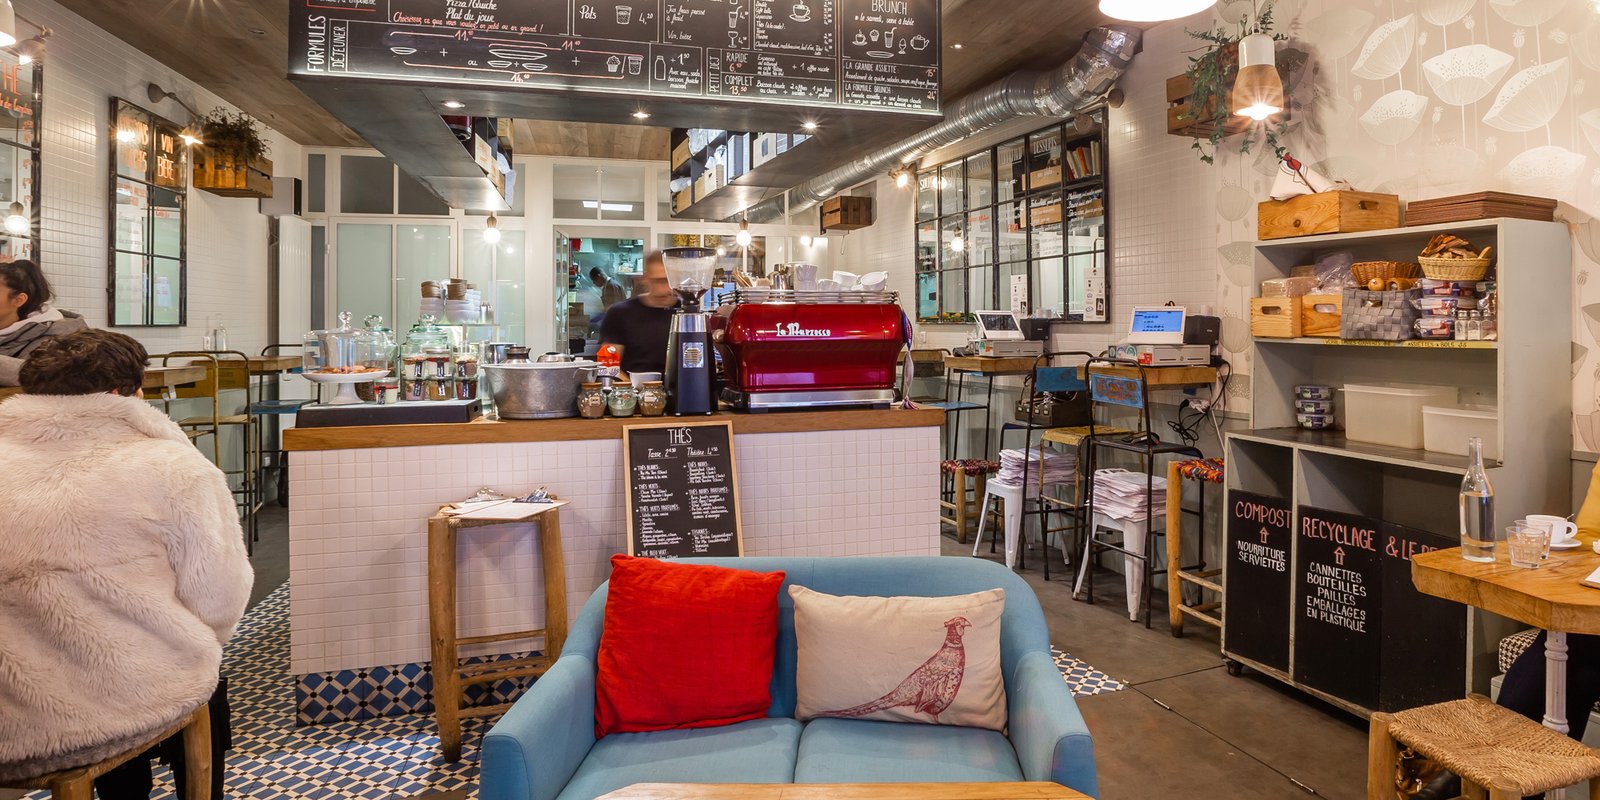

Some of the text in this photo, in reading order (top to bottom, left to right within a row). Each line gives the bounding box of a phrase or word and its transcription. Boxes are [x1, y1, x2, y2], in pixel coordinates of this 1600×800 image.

[446, 8, 495, 25] Plat du jour
[579, 5, 597, 20] Pots
[307, 14, 327, 73] FORMULES
[467, 59, 479, 67] ou
[726, 52, 749, 64] RAPIDE
[845, 62, 853, 70] LA
[854, 62, 874, 72] GRANDE
[724, 75, 755, 87] COMPLET
[845, 83, 852, 91] LA
[160, 133, 174, 155] VIN
[787, 322, 831, 337] Marzocco
[1235, 501, 1292, 528] COMPOST
[1302, 516, 1376, 551] RECYCLAGE
[1385, 535, 1398, 558] &
[1237, 540, 1286, 562] NOURRITURE
[1238, 551, 1286, 572] SERVIETTES
[1309, 562, 1362, 584] CANNETTES
[1307, 573, 1367, 597] BOUTEILLES
[1317, 587, 1356, 606] PAILLES
[1306, 596, 1366, 620] EMBALLAGES
[1306, 607, 1367, 634] EN PLASTIQUE
